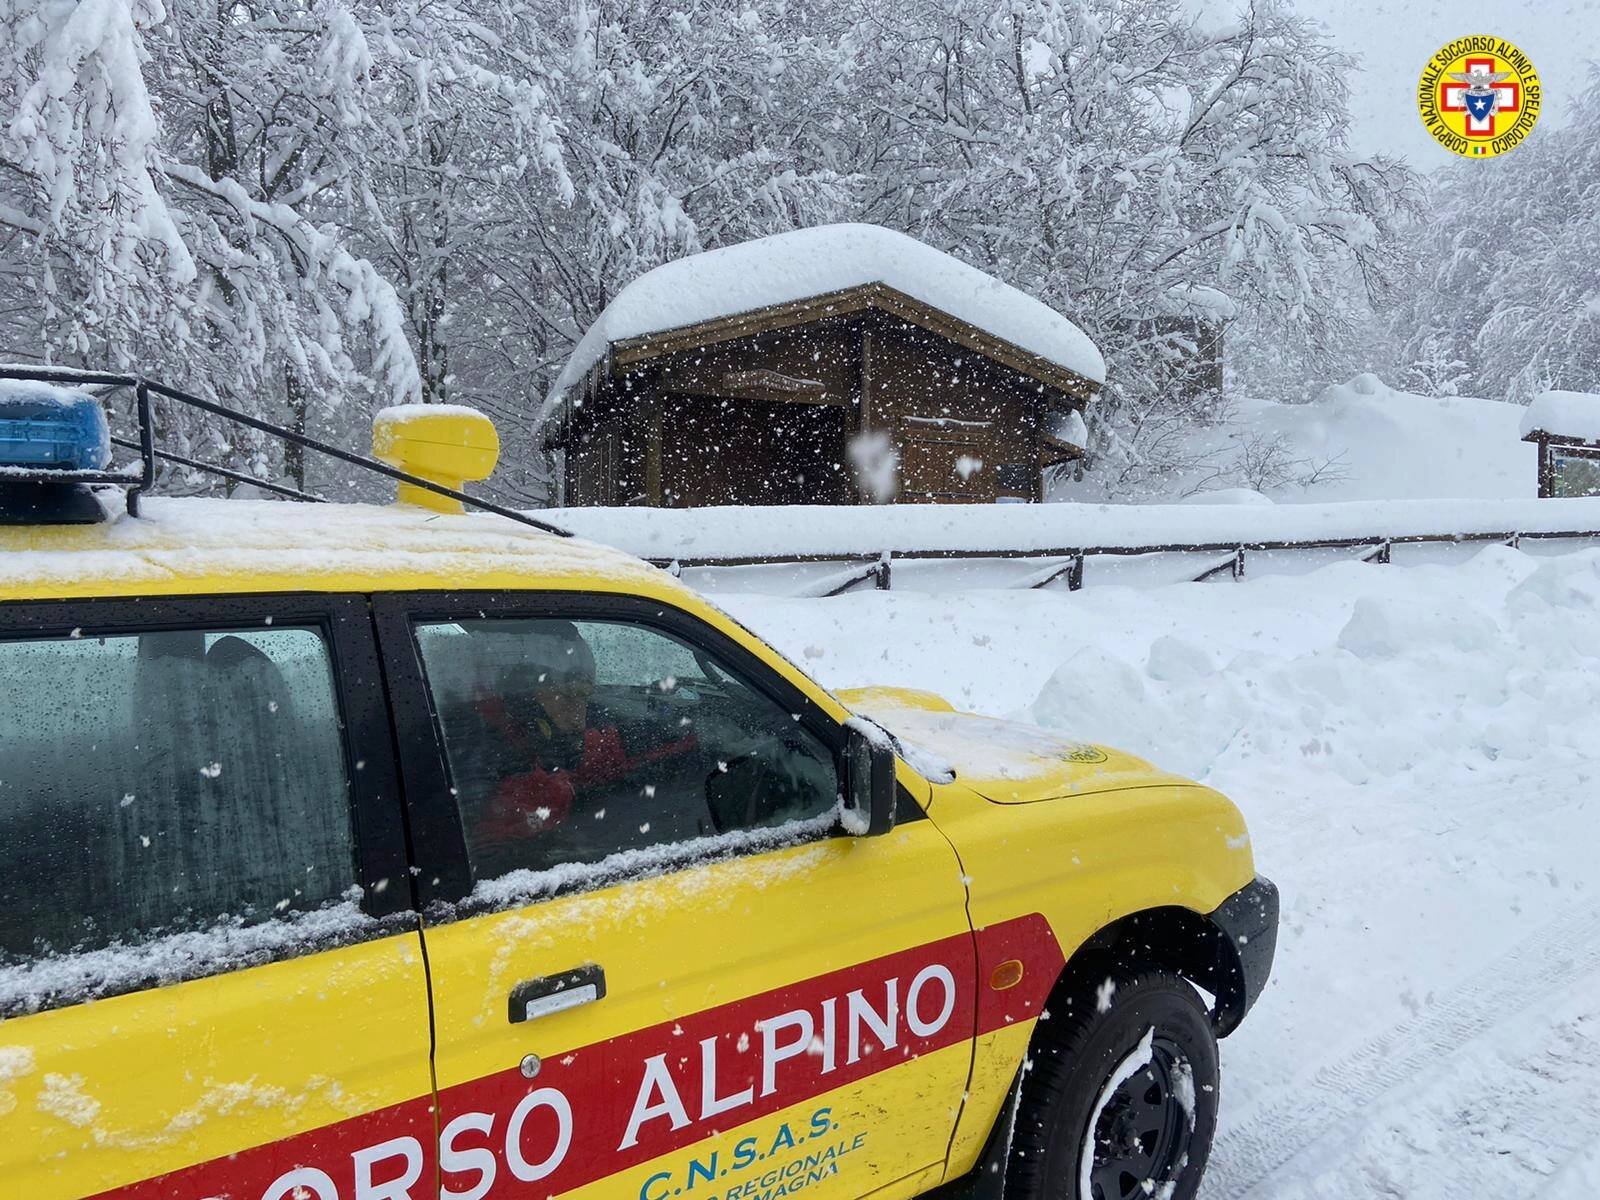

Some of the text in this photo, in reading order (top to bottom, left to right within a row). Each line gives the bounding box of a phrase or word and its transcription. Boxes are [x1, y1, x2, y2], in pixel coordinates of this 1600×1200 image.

[617, 964, 956, 1151] ALPINO
[639, 1107, 839, 1200] C.N.S.A.S.
[726, 1131, 867, 1200] REGIONALE
